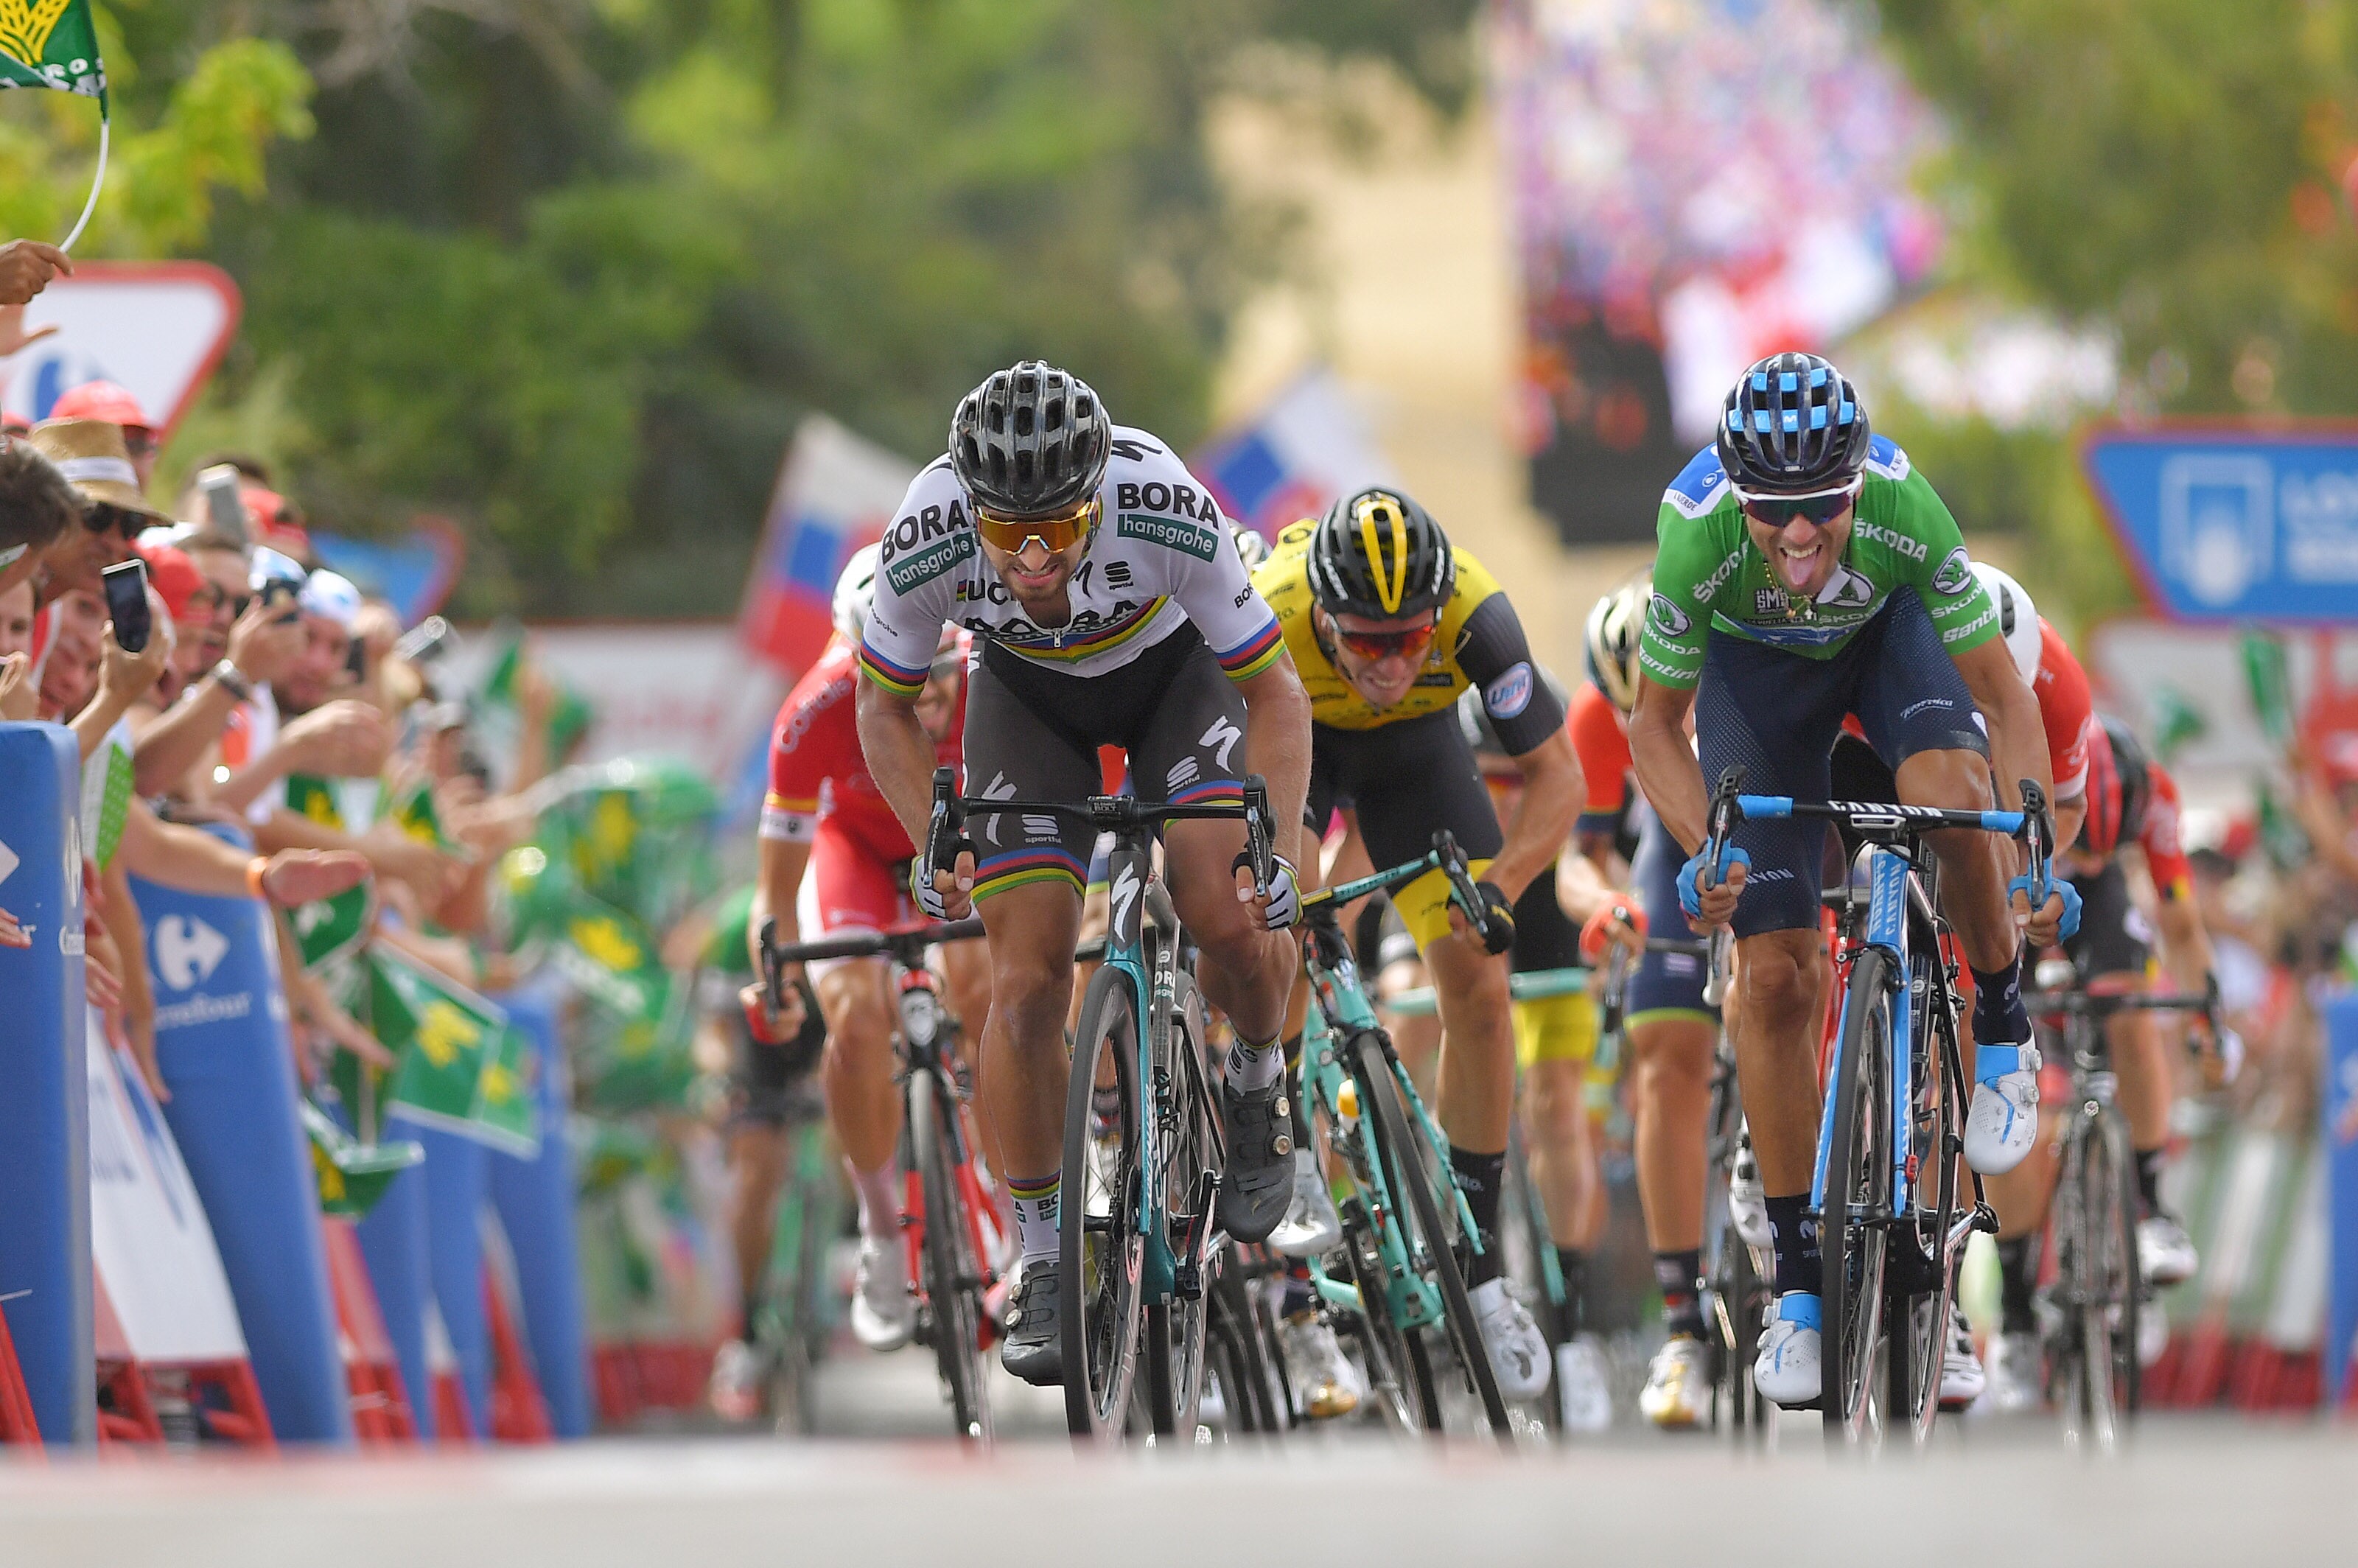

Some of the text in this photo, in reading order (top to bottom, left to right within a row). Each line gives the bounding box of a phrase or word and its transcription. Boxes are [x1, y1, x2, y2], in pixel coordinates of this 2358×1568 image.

[1117, 481, 1220, 531] BORA
[882, 500, 969, 565] BORA
[1124, 514, 1214, 553] hansgrohe
[1854, 517, 1928, 562] ŠKODA
[891, 537, 970, 589] hansgrohe
[1167, 774, 1201, 796] sportful
[1827, 800, 1944, 818] CANYON
[1024, 836, 1062, 844] sportful
[1886, 863, 1901, 936] CANYON
